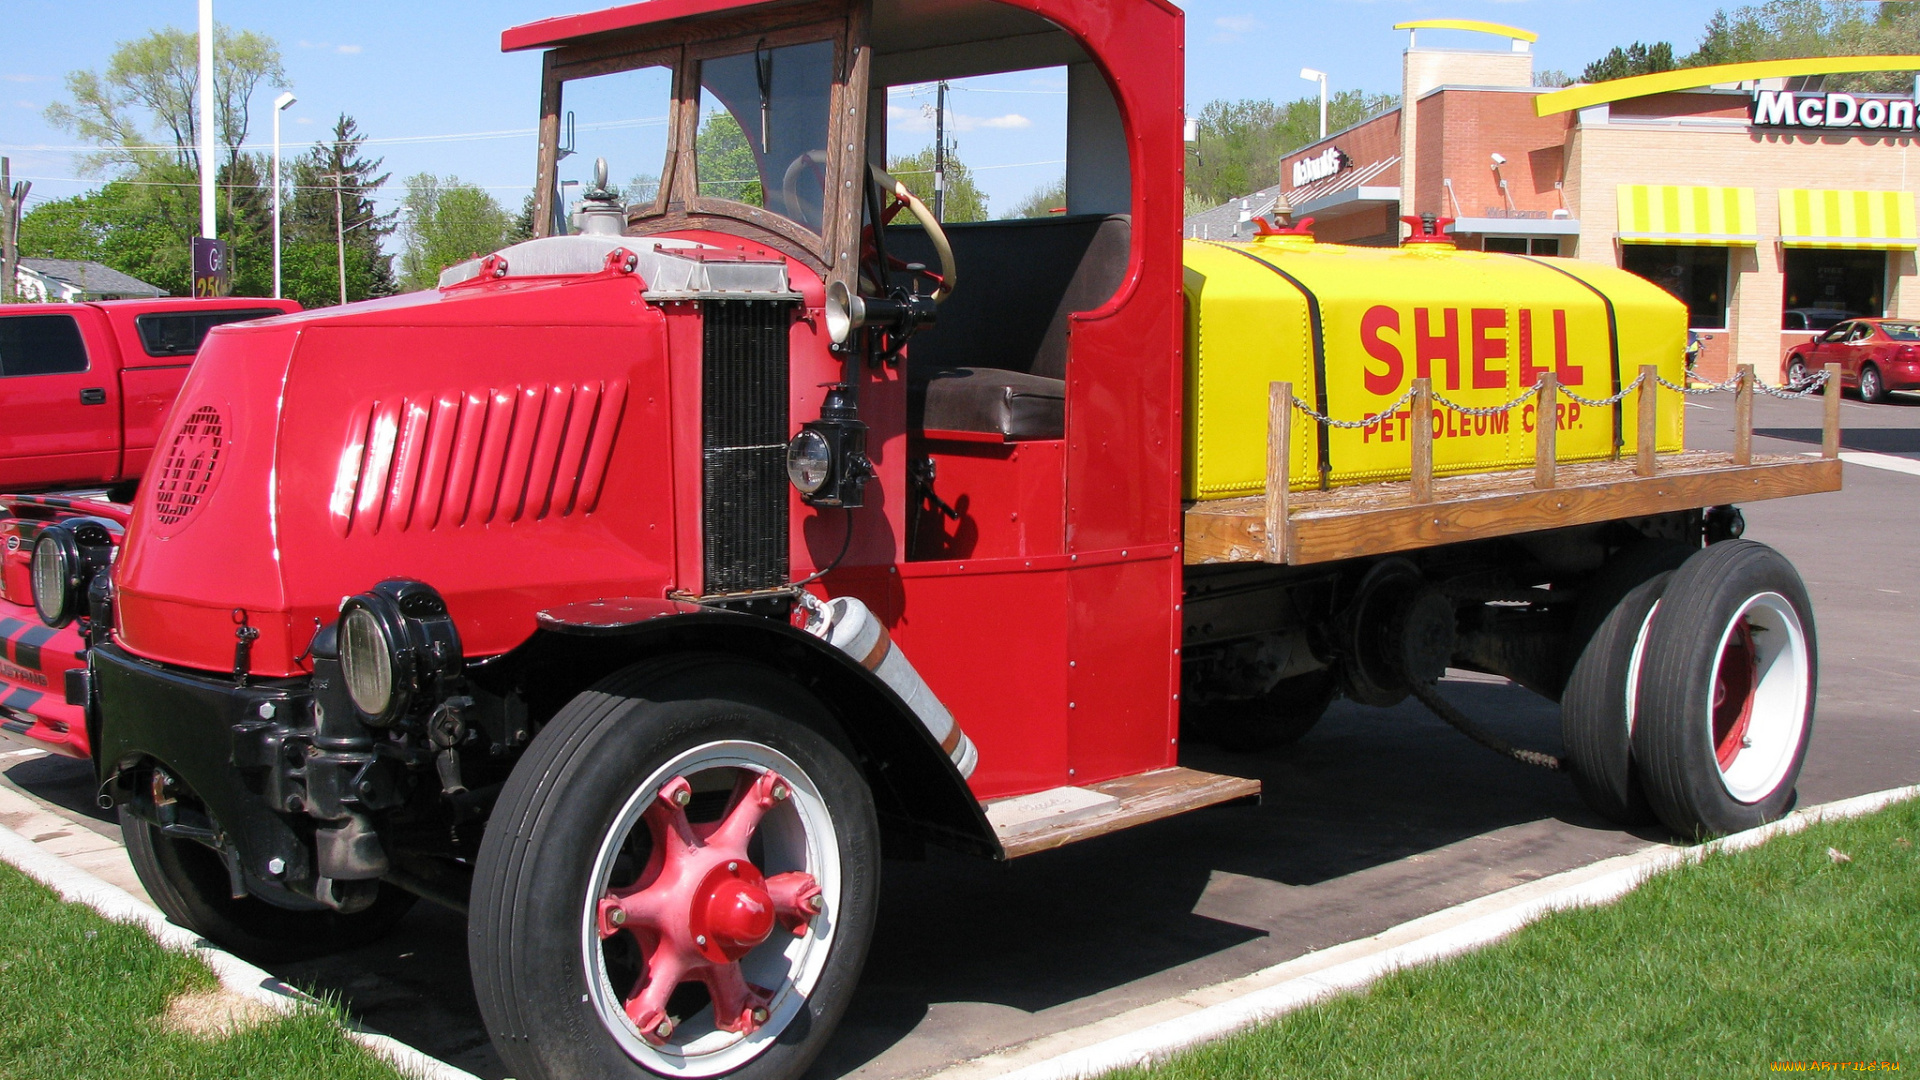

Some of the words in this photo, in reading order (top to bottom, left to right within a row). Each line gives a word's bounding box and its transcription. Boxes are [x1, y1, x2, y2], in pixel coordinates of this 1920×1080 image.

[1754, 91, 1920, 130] McDon
[1486, 207, 1548, 219] Welcome
[1360, 304, 1584, 396] SHELL
[1363, 406, 1509, 444] PETOLEUM
[1522, 402, 1584, 433] CRP.
